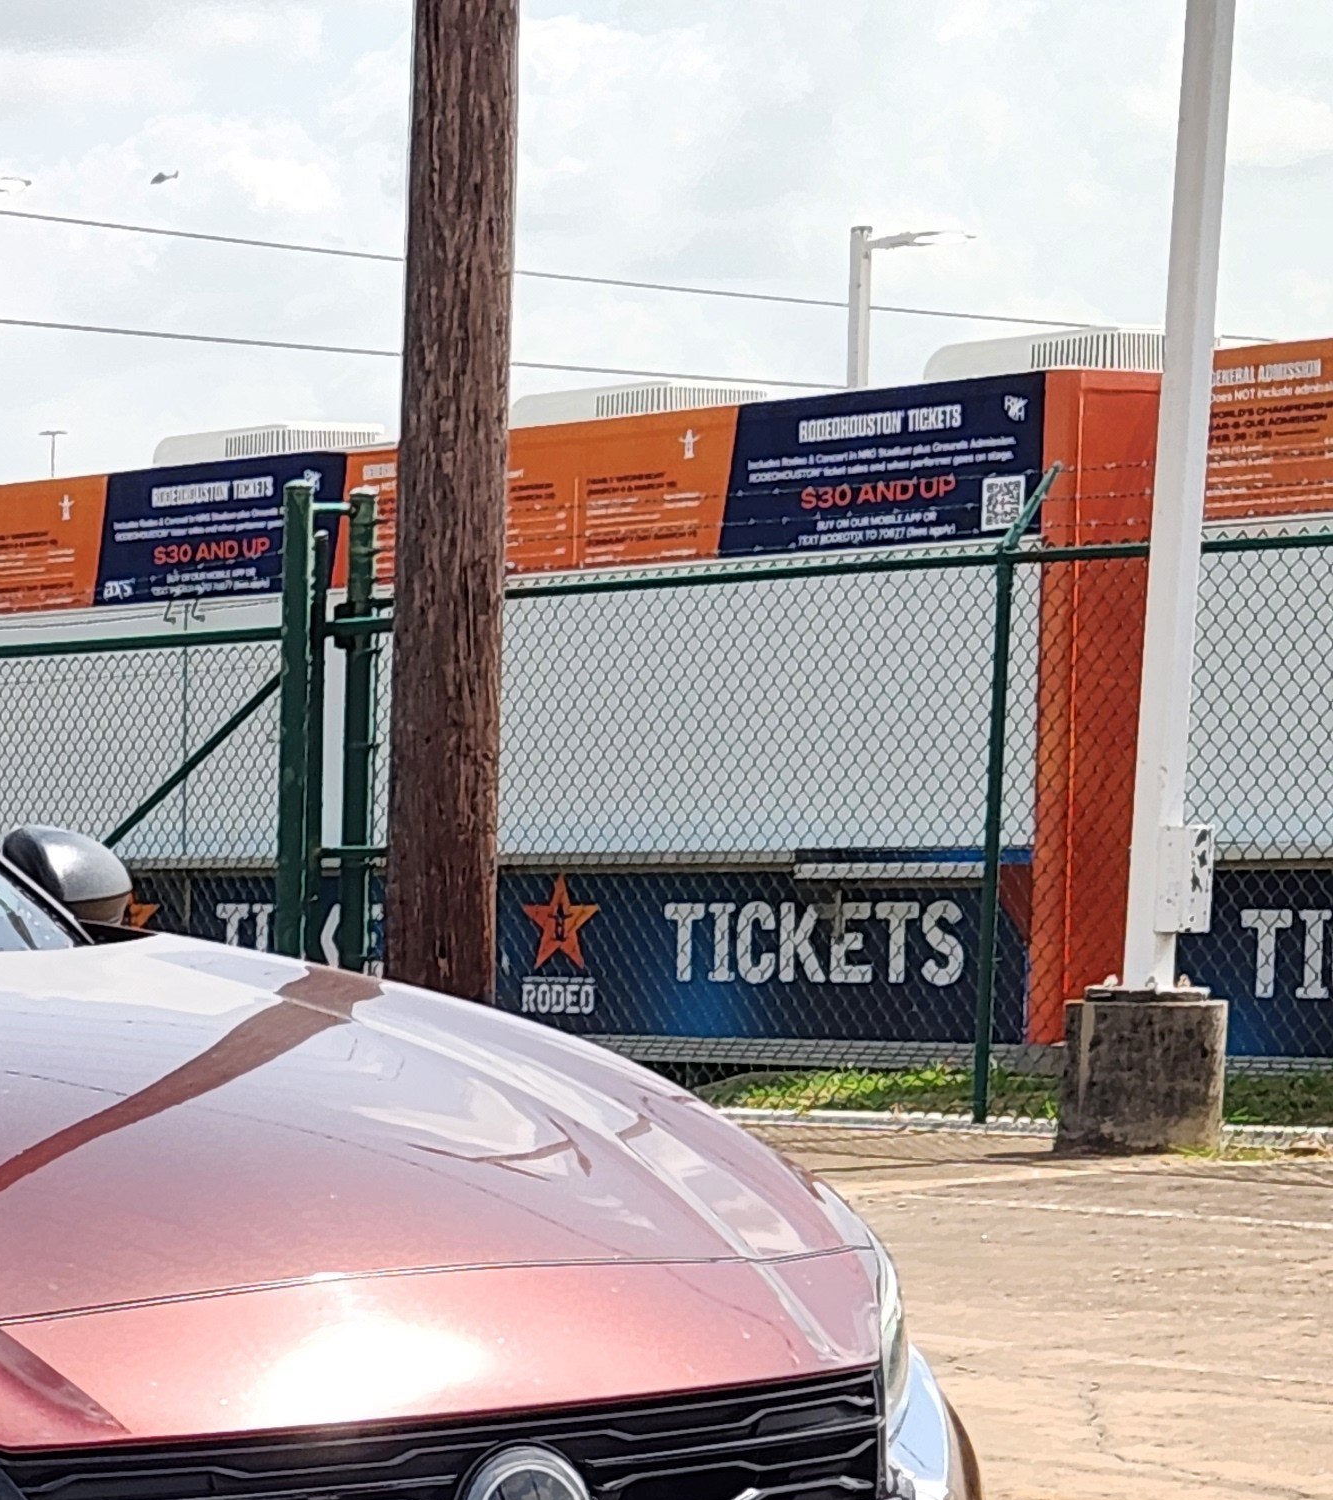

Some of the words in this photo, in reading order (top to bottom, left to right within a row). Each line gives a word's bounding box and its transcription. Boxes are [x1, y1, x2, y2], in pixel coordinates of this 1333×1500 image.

[1235, 388, 1255, 400] NOT
[907, 404, 962, 432] TICKETS
[801, 485, 851, 509] $30
[857, 481, 914, 504] AND
[919, 476, 956, 499] UP
[153, 543, 192, 565] $30
[195, 540, 239, 561] AND
[242, 537, 270, 558] UP
[664, 900, 964, 986] TICKETS
[522, 983, 595, 1014] RODEO
